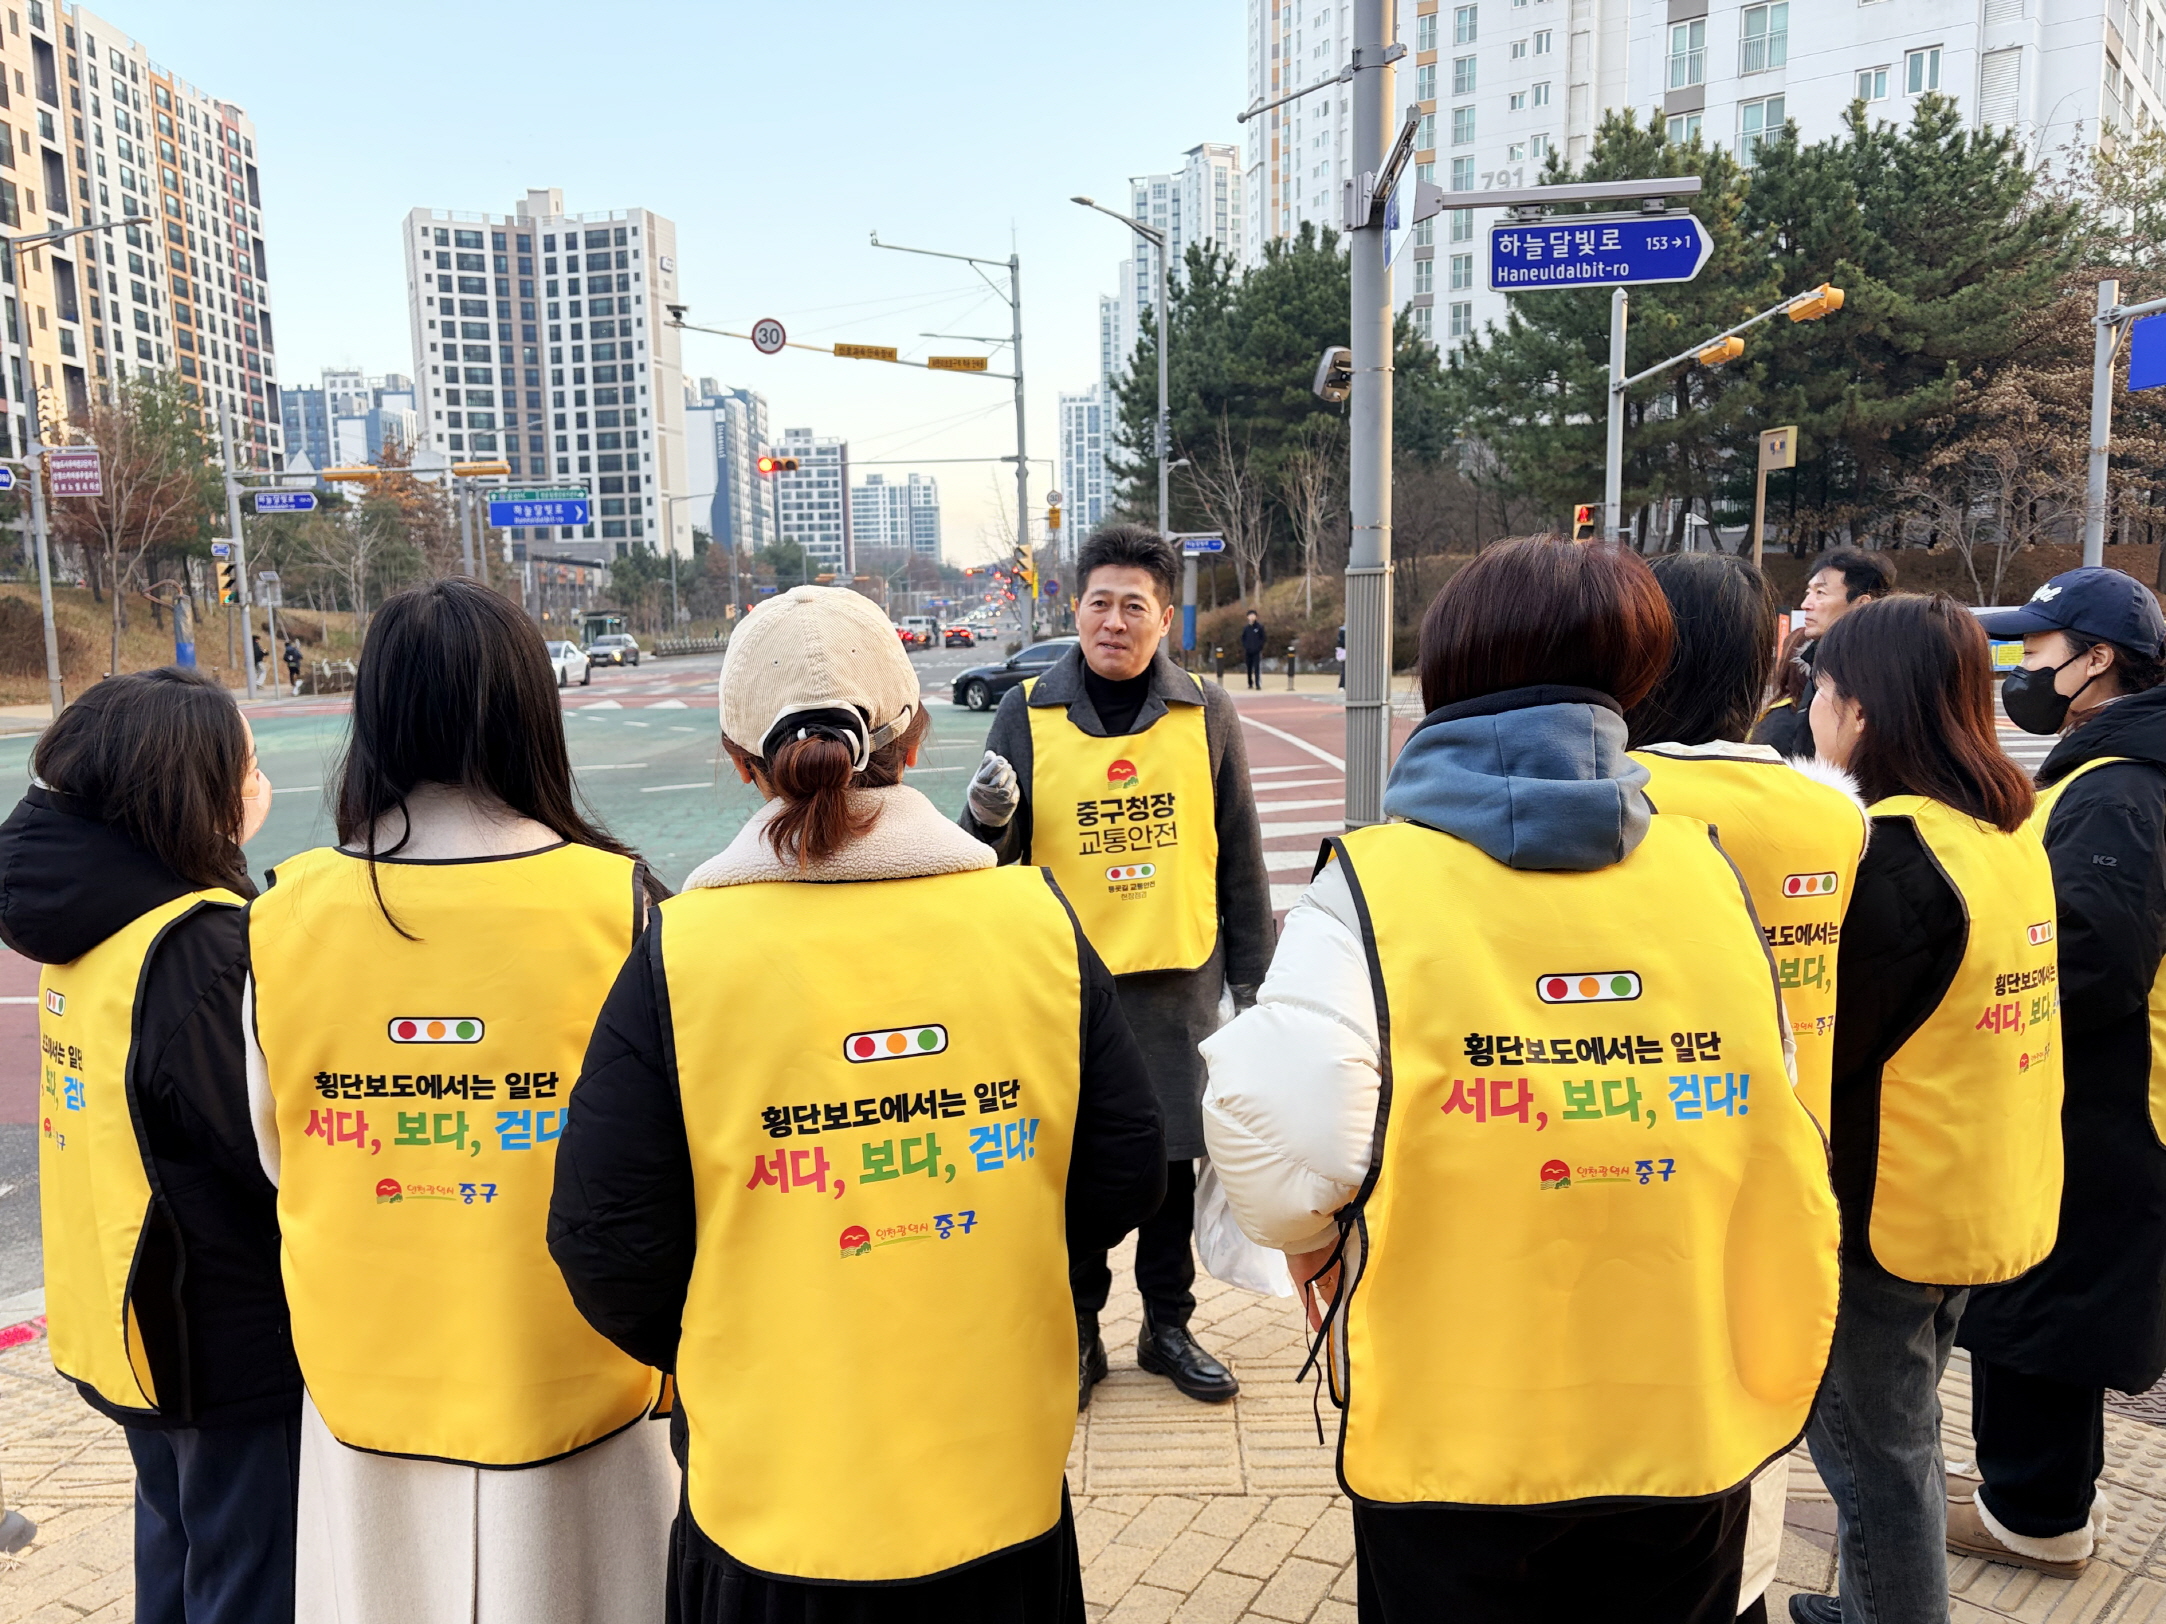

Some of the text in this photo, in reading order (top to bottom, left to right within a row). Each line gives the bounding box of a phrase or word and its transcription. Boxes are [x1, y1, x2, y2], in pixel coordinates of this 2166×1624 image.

[1481, 167, 1523, 189] 791
[1498, 229, 1622, 261] 하늘달빛로
[1645, 236, 1668, 251] 153
[1498, 263, 1629, 282] Haneuldalbit-ro
[758, 327, 780, 345] 30
[1077, 793, 1176, 826] 중구청장
[1079, 821, 1178, 856] 교통안전
[2092, 854, 2118, 867] K2
[1779, 954, 1831, 994] 보다,
[1816, 1015, 1834, 1036] 중구
[1976, 1001, 2026, 1036] 서다,
[1463, 1031, 1721, 1066] 횡단보도에서는 일단
[314, 1072, 559, 1100] 횡단보도에서는 일단
[1440, 1073, 1750, 1131] 서다, 보다, 걷다!
[761, 1079, 1020, 1138] 횡단보도에서는 일단
[304, 1108, 381, 1155] 서다,
[394, 1111, 481, 1157] 보다,
[746, 1118, 1040, 1199] 서다, 보다, 걷다!
[1577, 1158, 1676, 1184] 인천광역시 중구
[407, 1183, 499, 1204] 인천광역시 중구
[875, 1210, 978, 1241] 인천광역시 중구
